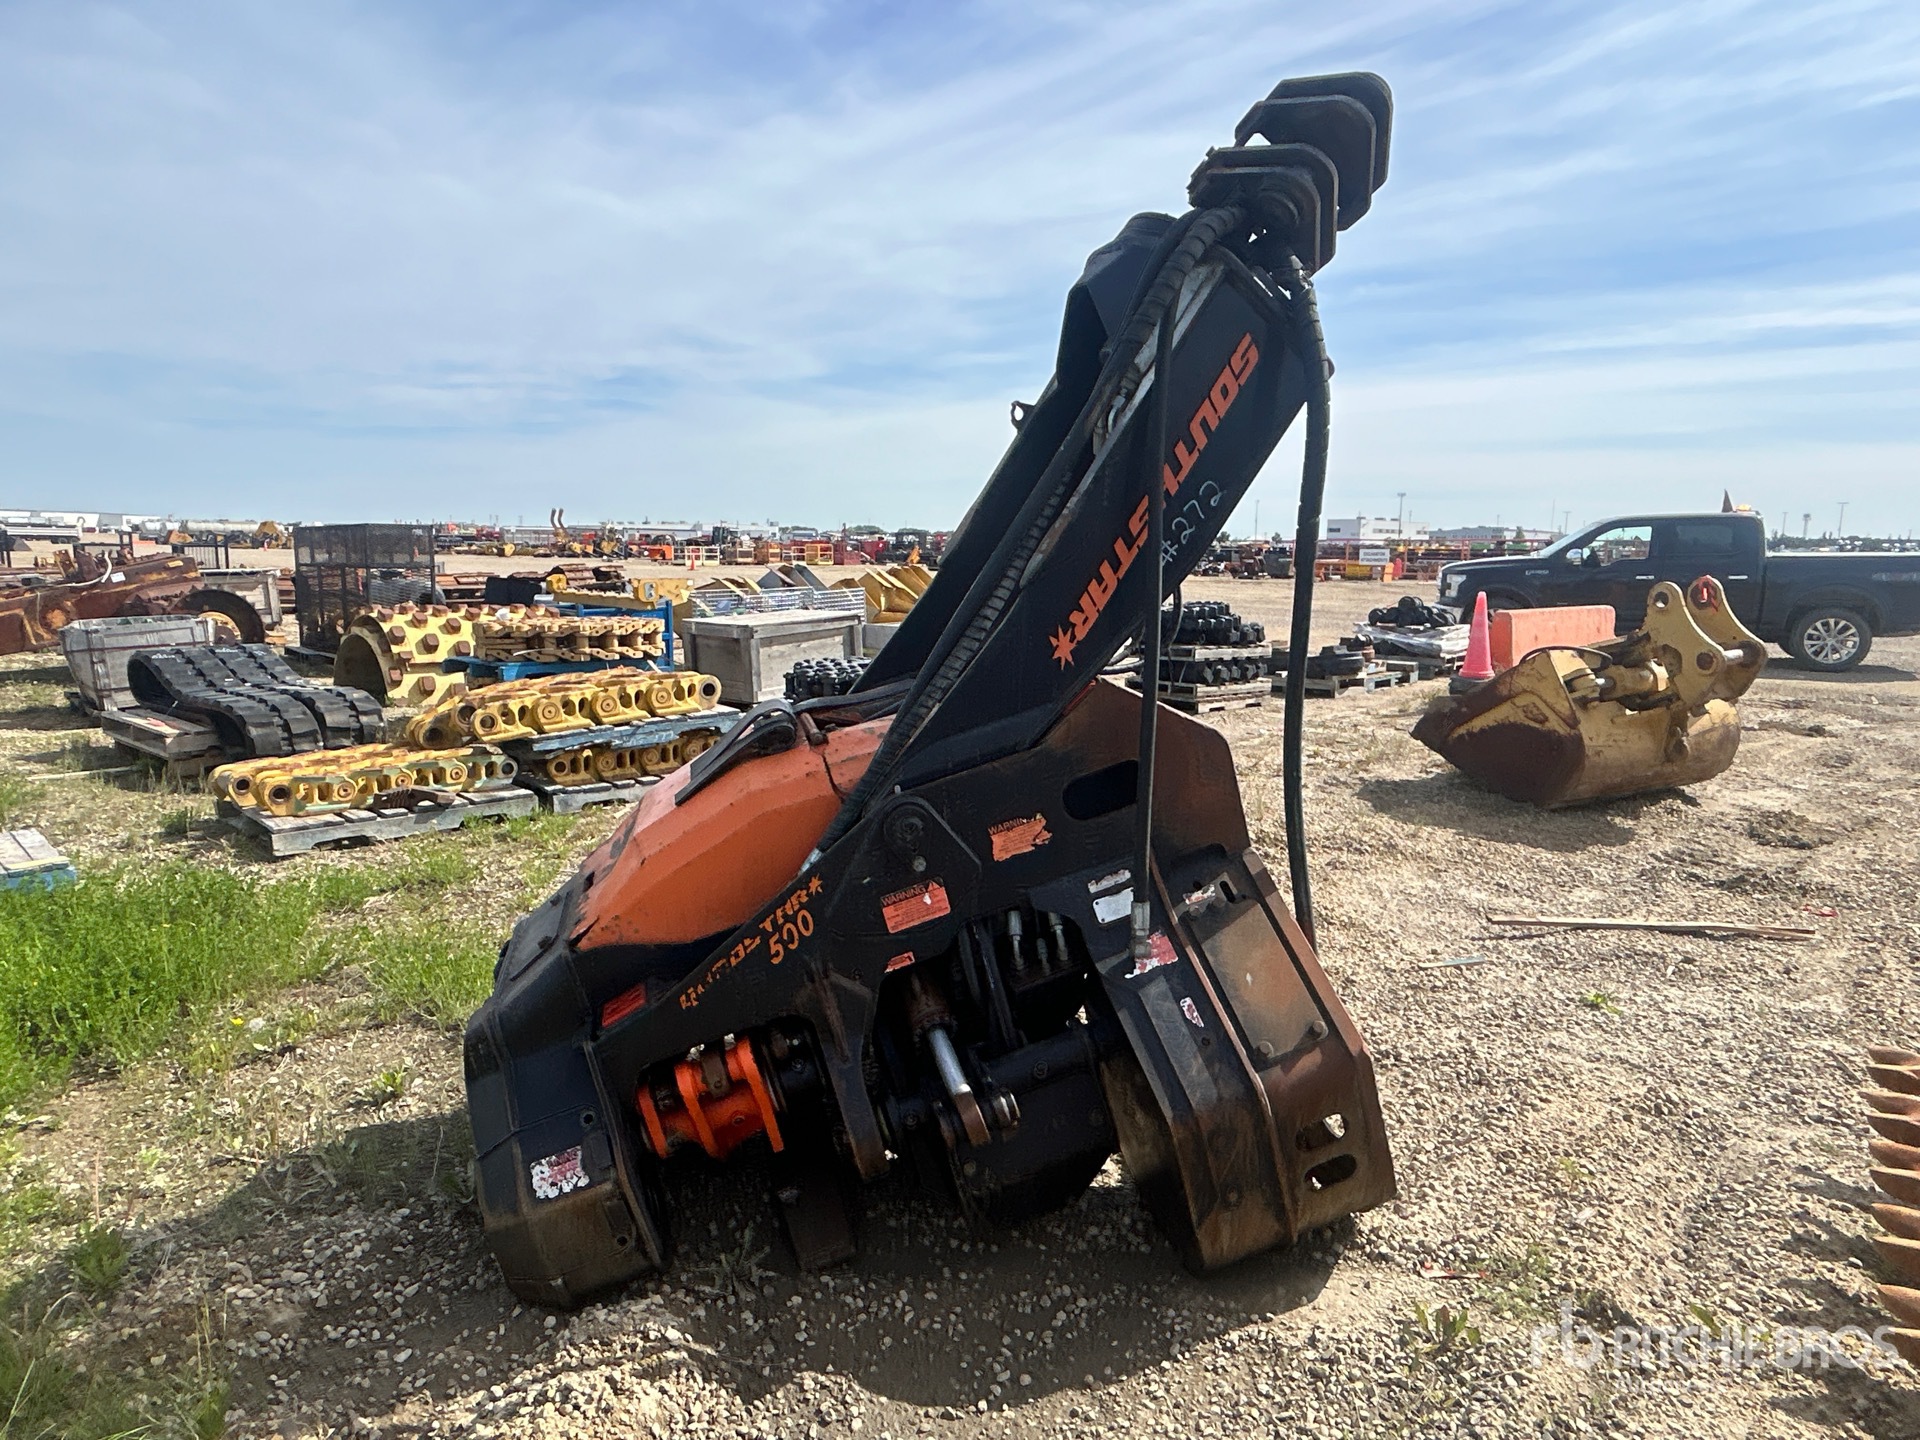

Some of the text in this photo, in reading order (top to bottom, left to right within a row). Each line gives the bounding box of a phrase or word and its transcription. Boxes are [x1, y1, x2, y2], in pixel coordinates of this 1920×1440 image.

[1161, 480, 1227, 567] #272
[987, 817, 1034, 836] WARNIN
[881, 884, 927, 907] WARNING
[768, 908, 815, 965] 500
